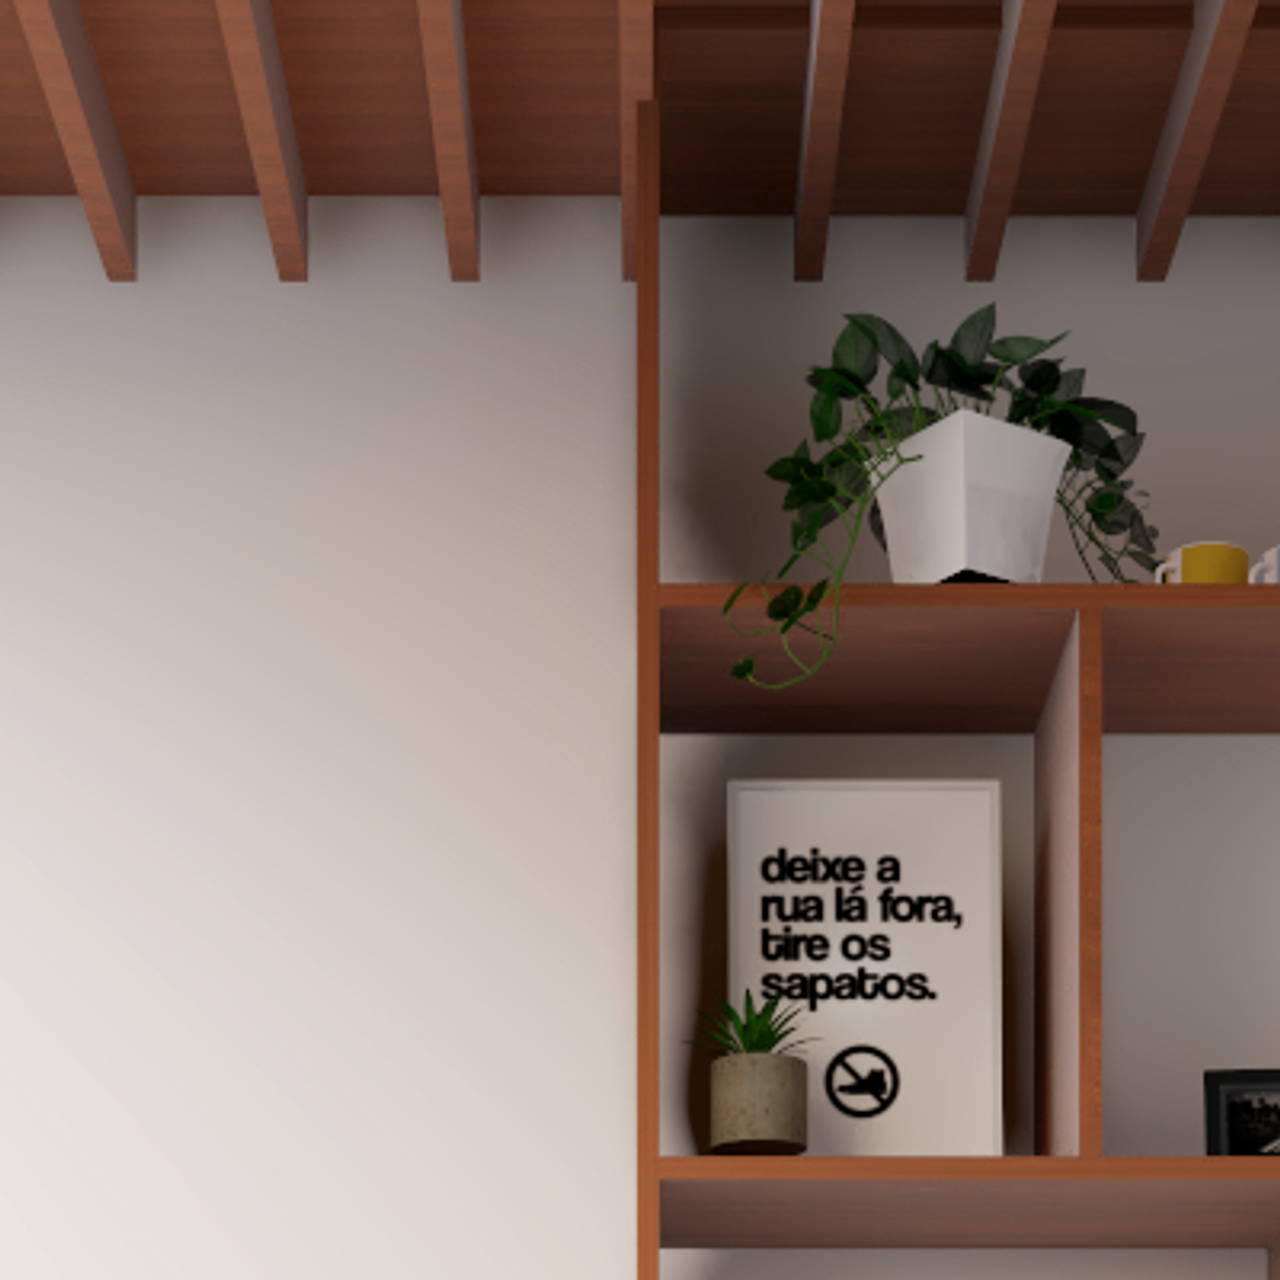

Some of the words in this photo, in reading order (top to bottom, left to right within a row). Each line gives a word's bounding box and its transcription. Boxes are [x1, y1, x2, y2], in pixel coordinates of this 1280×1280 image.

[760, 847, 865, 884] deixe
[876, 855, 901, 884] a
[761, 894, 824, 923] rua
[835, 886, 867, 923] lá
[877, 886, 963, 930] fora,
[761, 926, 830, 961] tire
[841, 933, 891, 961] os
[761, 967, 938, 1012] sapatos.
